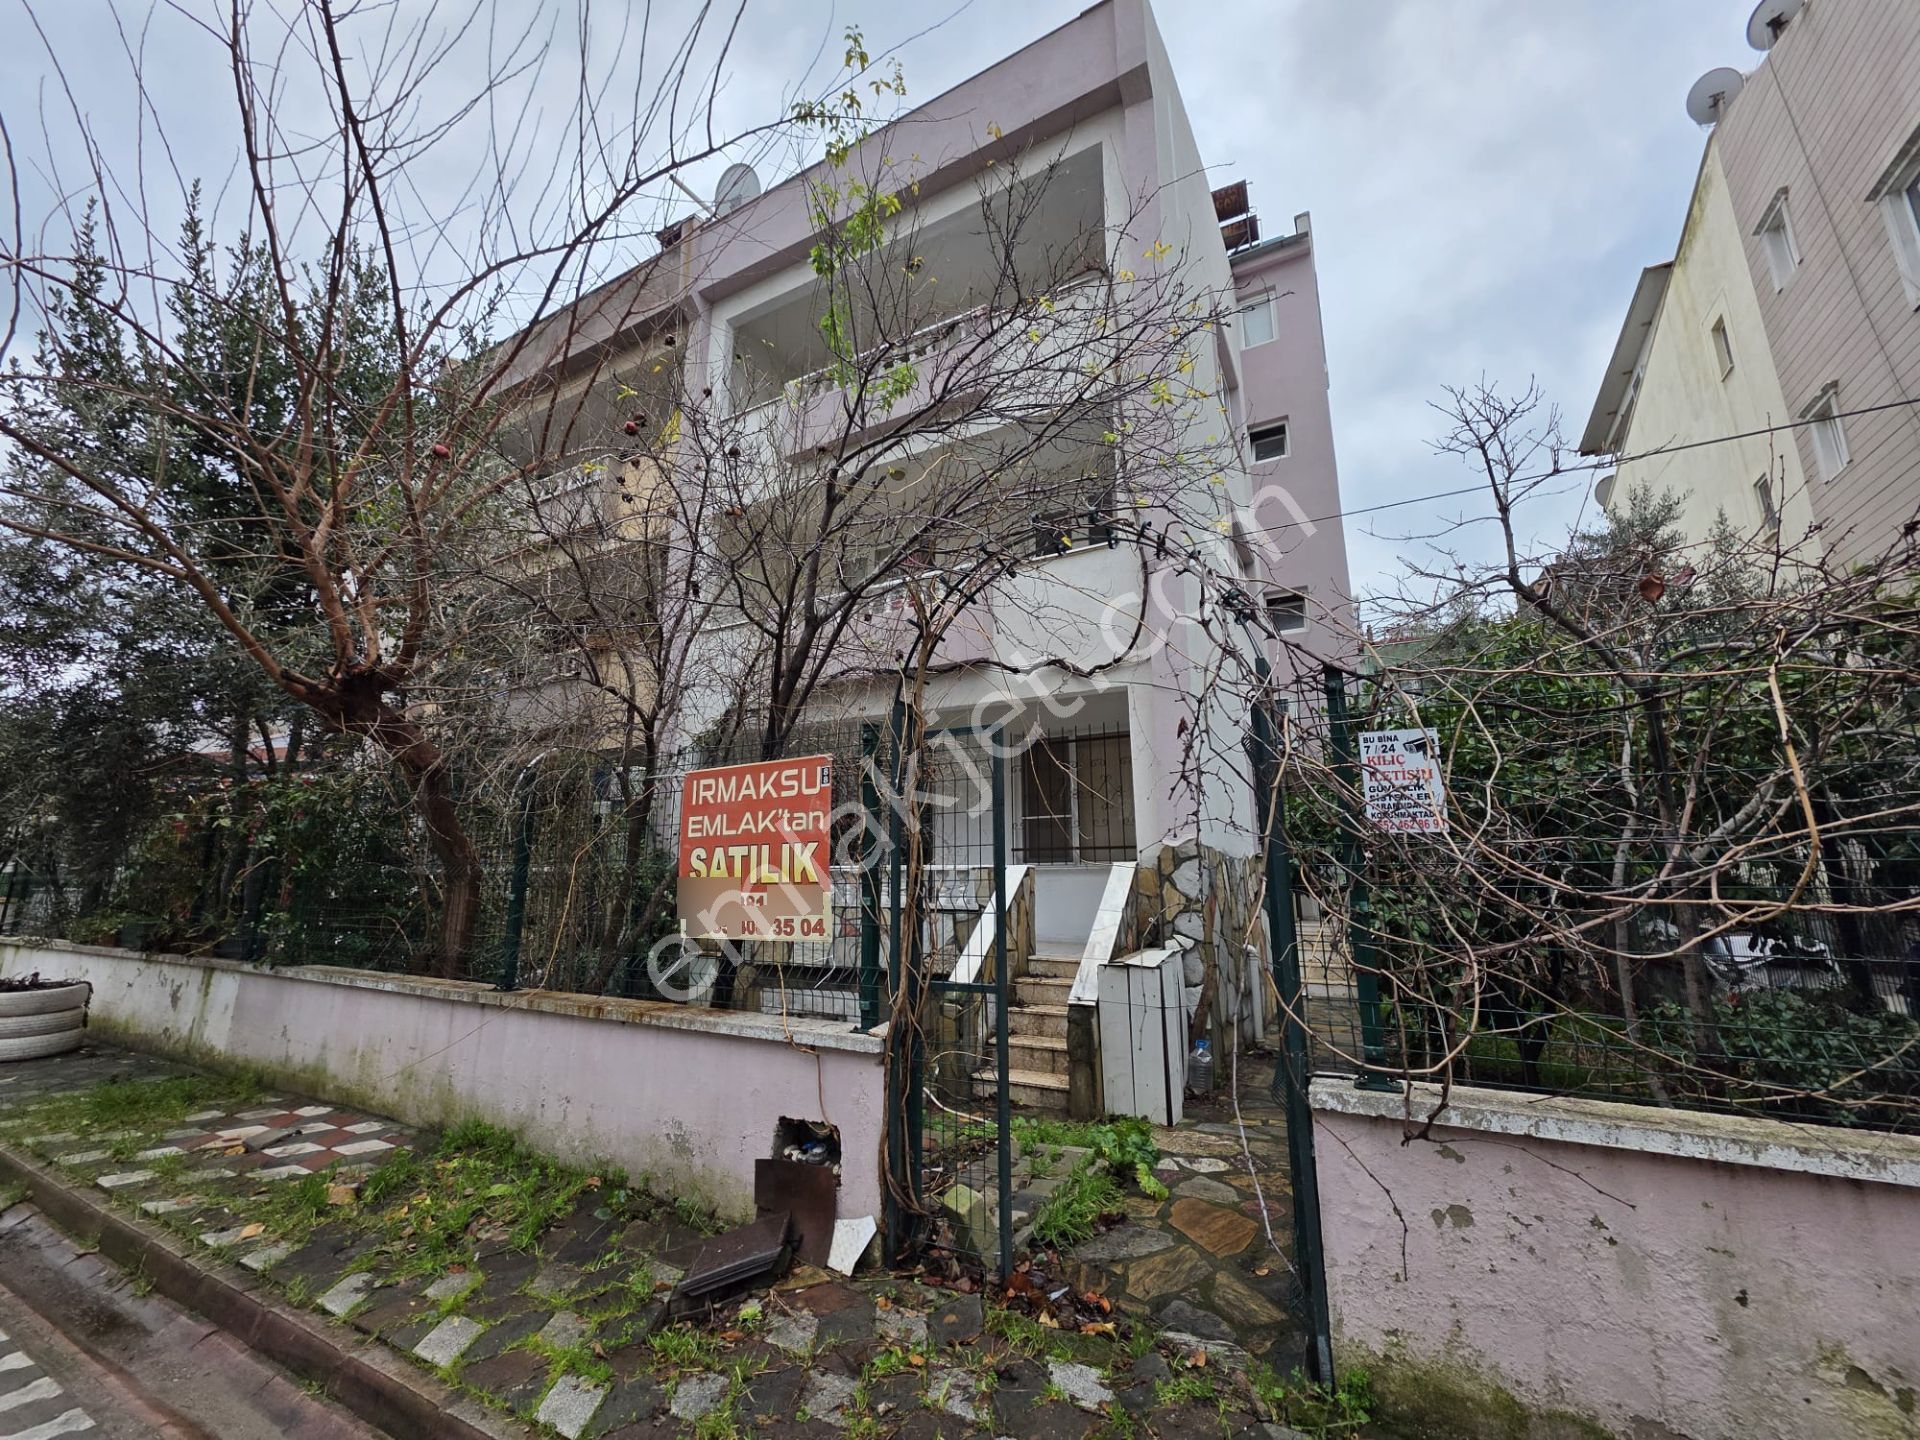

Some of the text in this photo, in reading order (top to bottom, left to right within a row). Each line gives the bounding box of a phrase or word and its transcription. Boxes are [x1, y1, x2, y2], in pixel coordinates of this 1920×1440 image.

[1363, 734, 1399, 744] BU BİNA
[1363, 745, 1371, 755] 7
[1380, 744, 1396, 754] 24
[692, 766, 821, 806] IRMAKSU
[687, 808, 824, 838] EMLAK'tan
[689, 841, 820, 884] SATILIK
[773, 918, 795, 937] 35
[800, 918, 826, 937] 04
